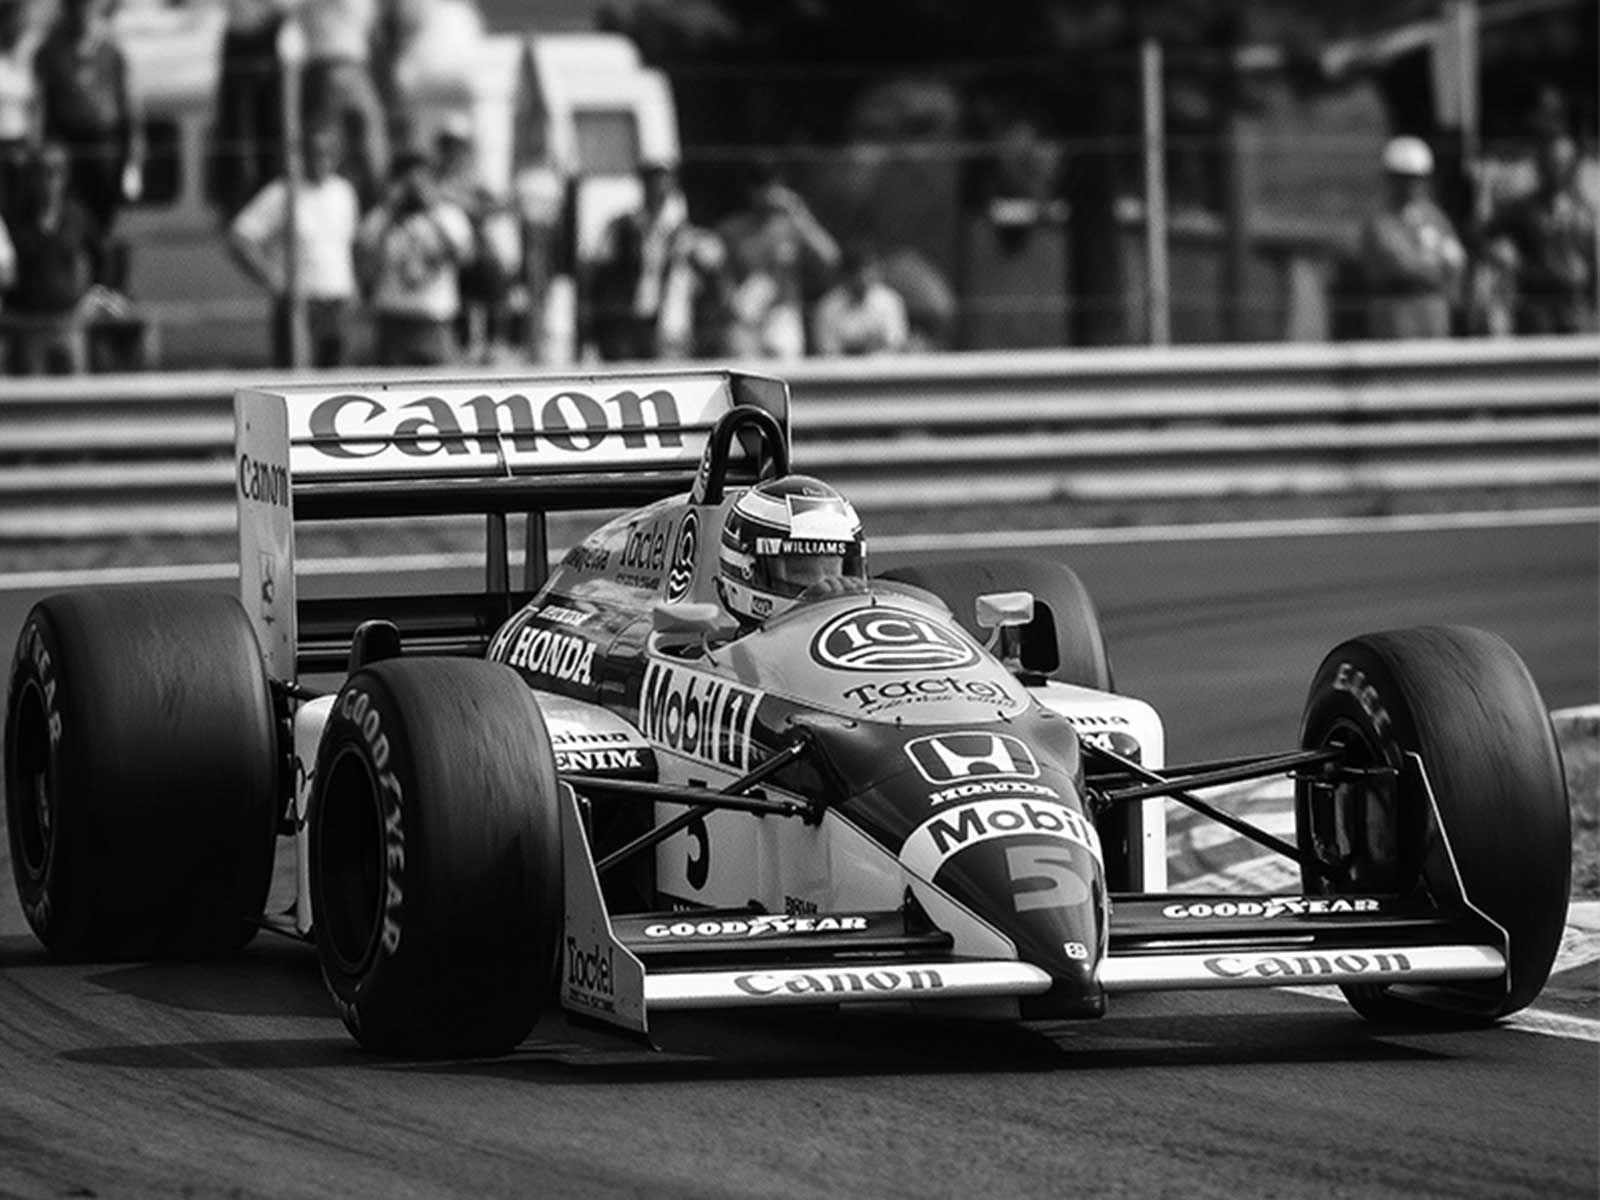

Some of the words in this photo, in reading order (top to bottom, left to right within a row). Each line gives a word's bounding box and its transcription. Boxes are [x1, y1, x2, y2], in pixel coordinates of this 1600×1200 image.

[309, 390, 683, 458] Canon
[782, 541, 847, 555] WILLIAMS
[838, 619, 949, 648] ICI
[509, 626, 597, 686] HONDA
[843, 677, 1013, 709] Tactel
[644, 664, 723, 763] Mobil
[553, 731, 630, 744] aima
[554, 750, 642, 771] ENIM
[928, 782, 1060, 806] HONDA
[927, 802, 1094, 855] Mobil
[1005, 846, 1089, 912] 5
[1203, 953, 1412, 977] Canon
[734, 970, 943, 996] Canon
